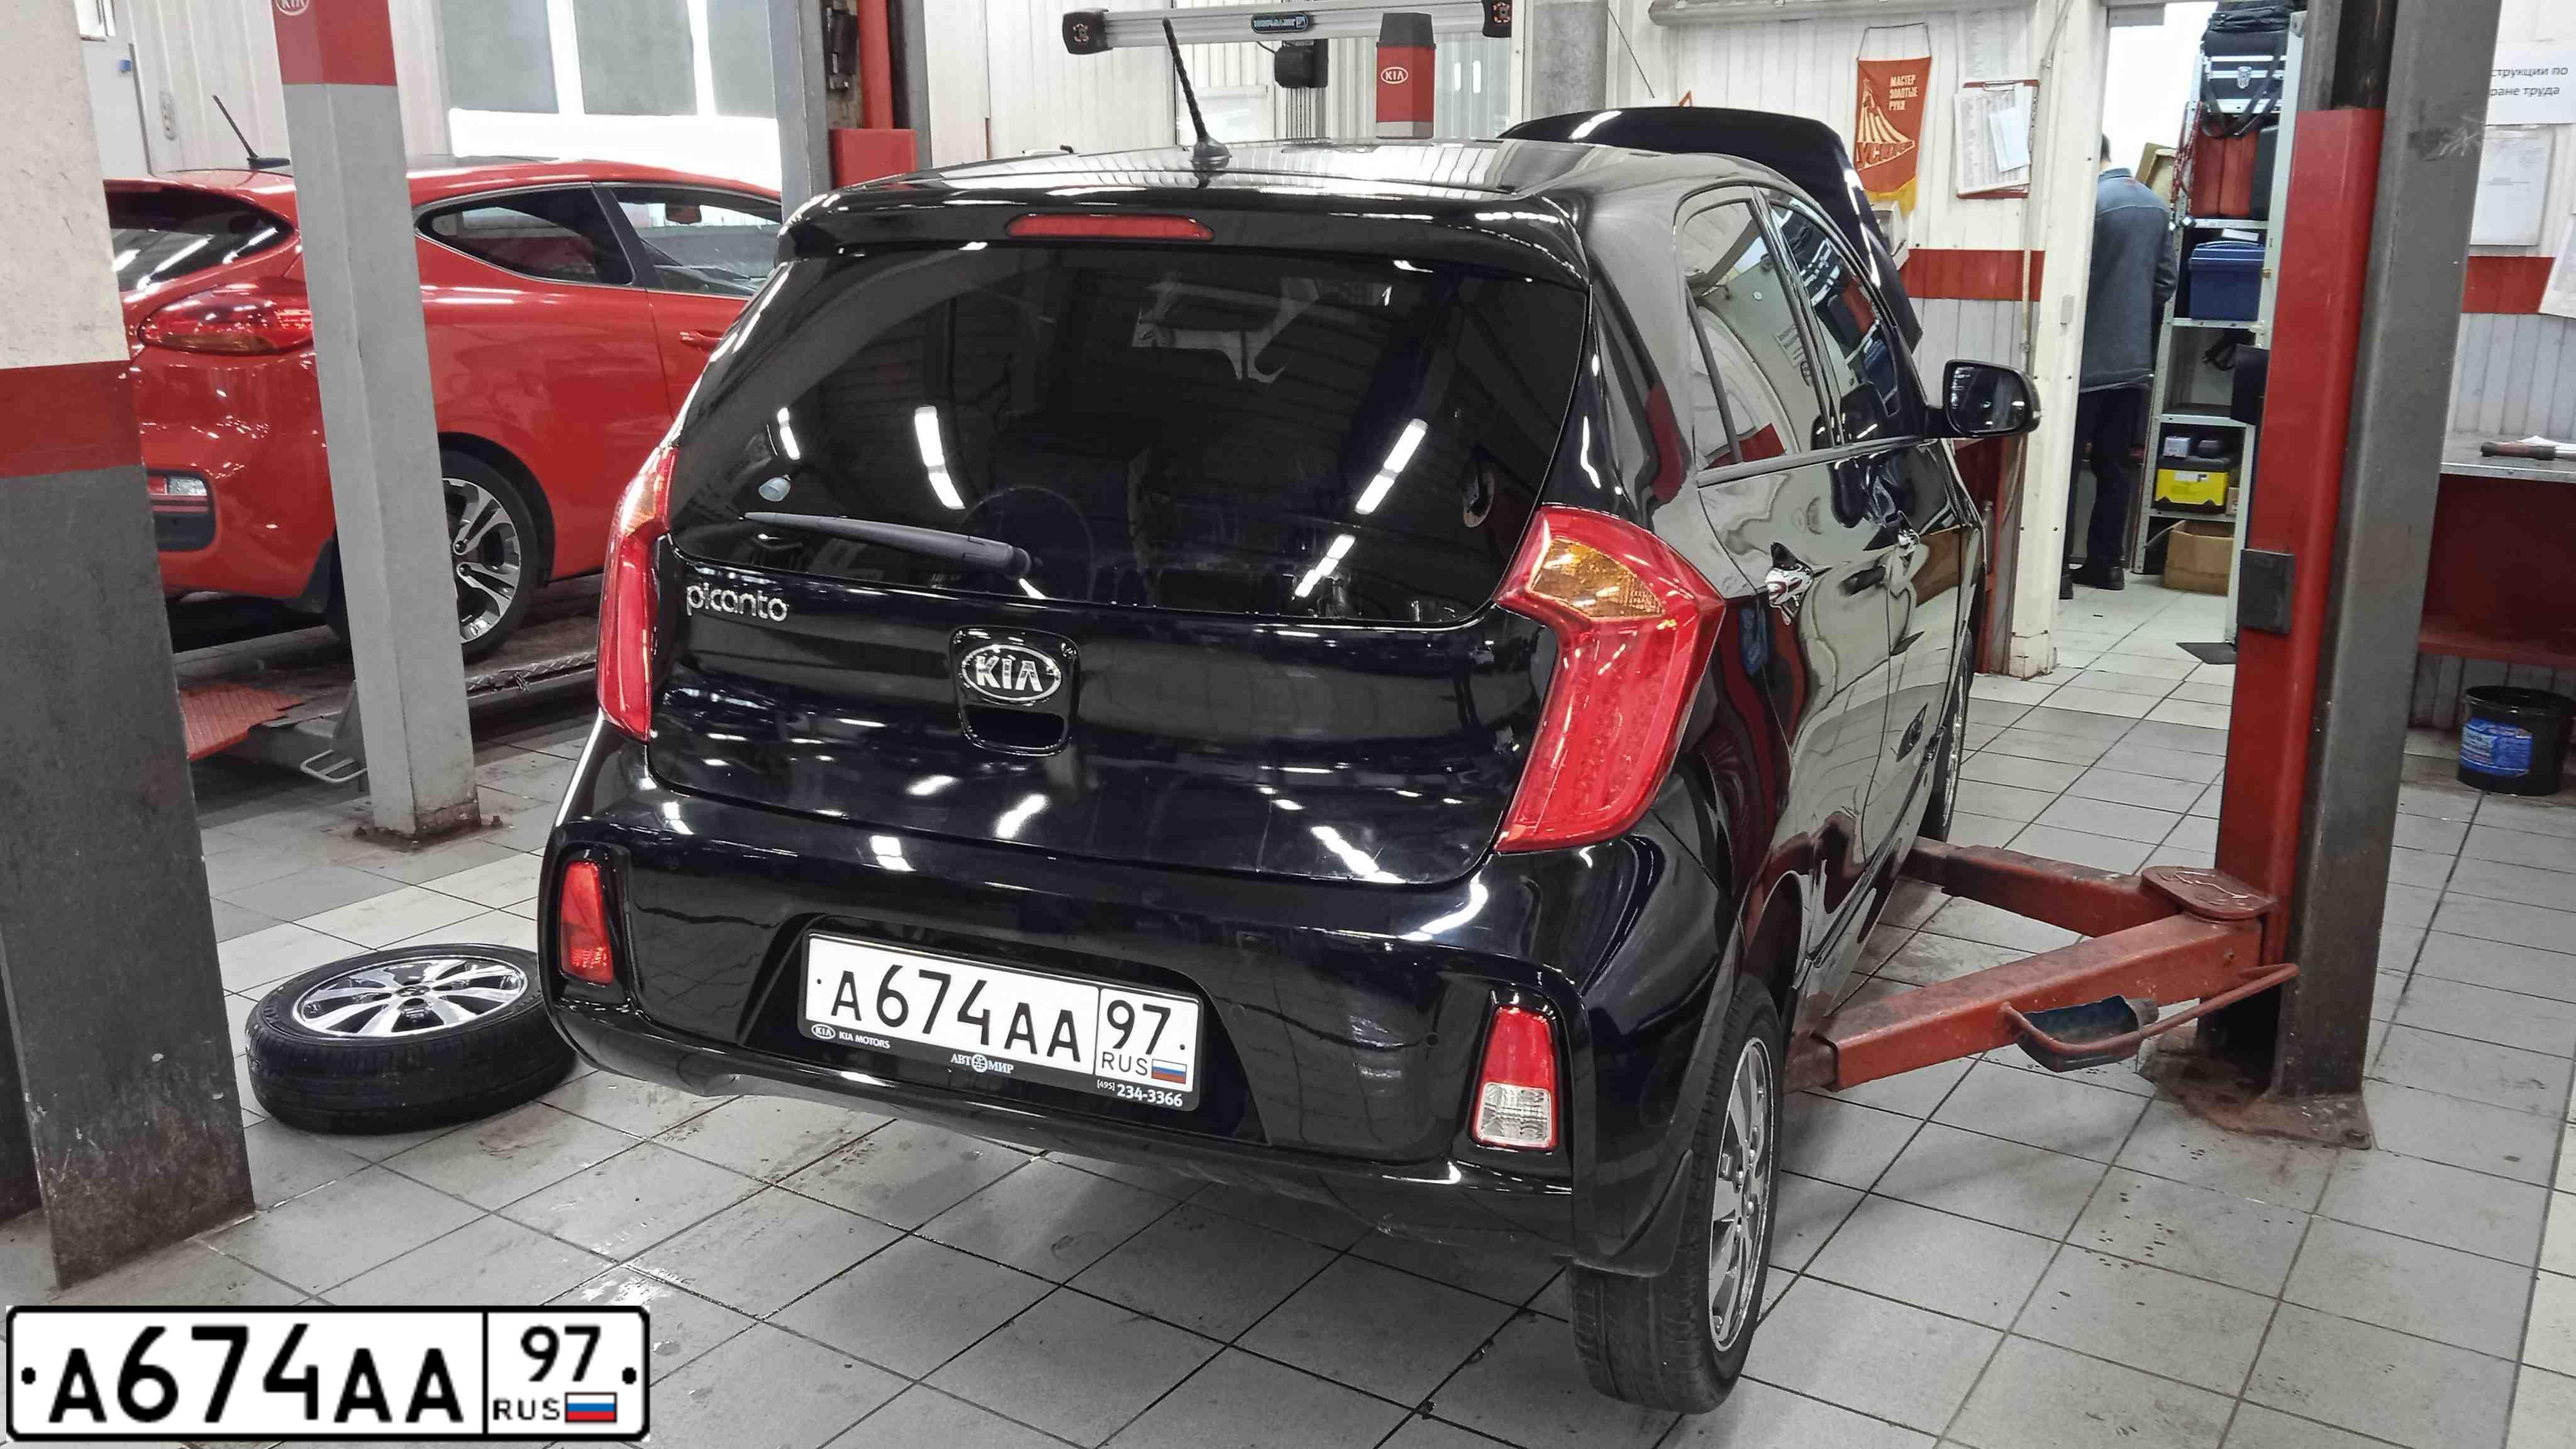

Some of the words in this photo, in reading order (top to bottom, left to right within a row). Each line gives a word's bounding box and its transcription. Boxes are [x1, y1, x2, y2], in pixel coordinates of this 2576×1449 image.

[1385, 70, 1404, 80] KIA
[1889, 74, 1916, 87] МАСТЕР
[2551, 67, 2568, 75] по
[2523, 87, 2560, 97] труда
[687, 582, 788, 622] picanto
[975, 654, 1043, 692] KIA
[830, 963, 1082, 1063] А674АА
[1107, 999, 1171, 1055] 97
[839, 1031, 854, 1041] KIA
[855, 1035, 891, 1049] MOTORS
[1102, 1051, 1148, 1075] RUS
[1117, 1083, 1183, 1107] 234-3366
